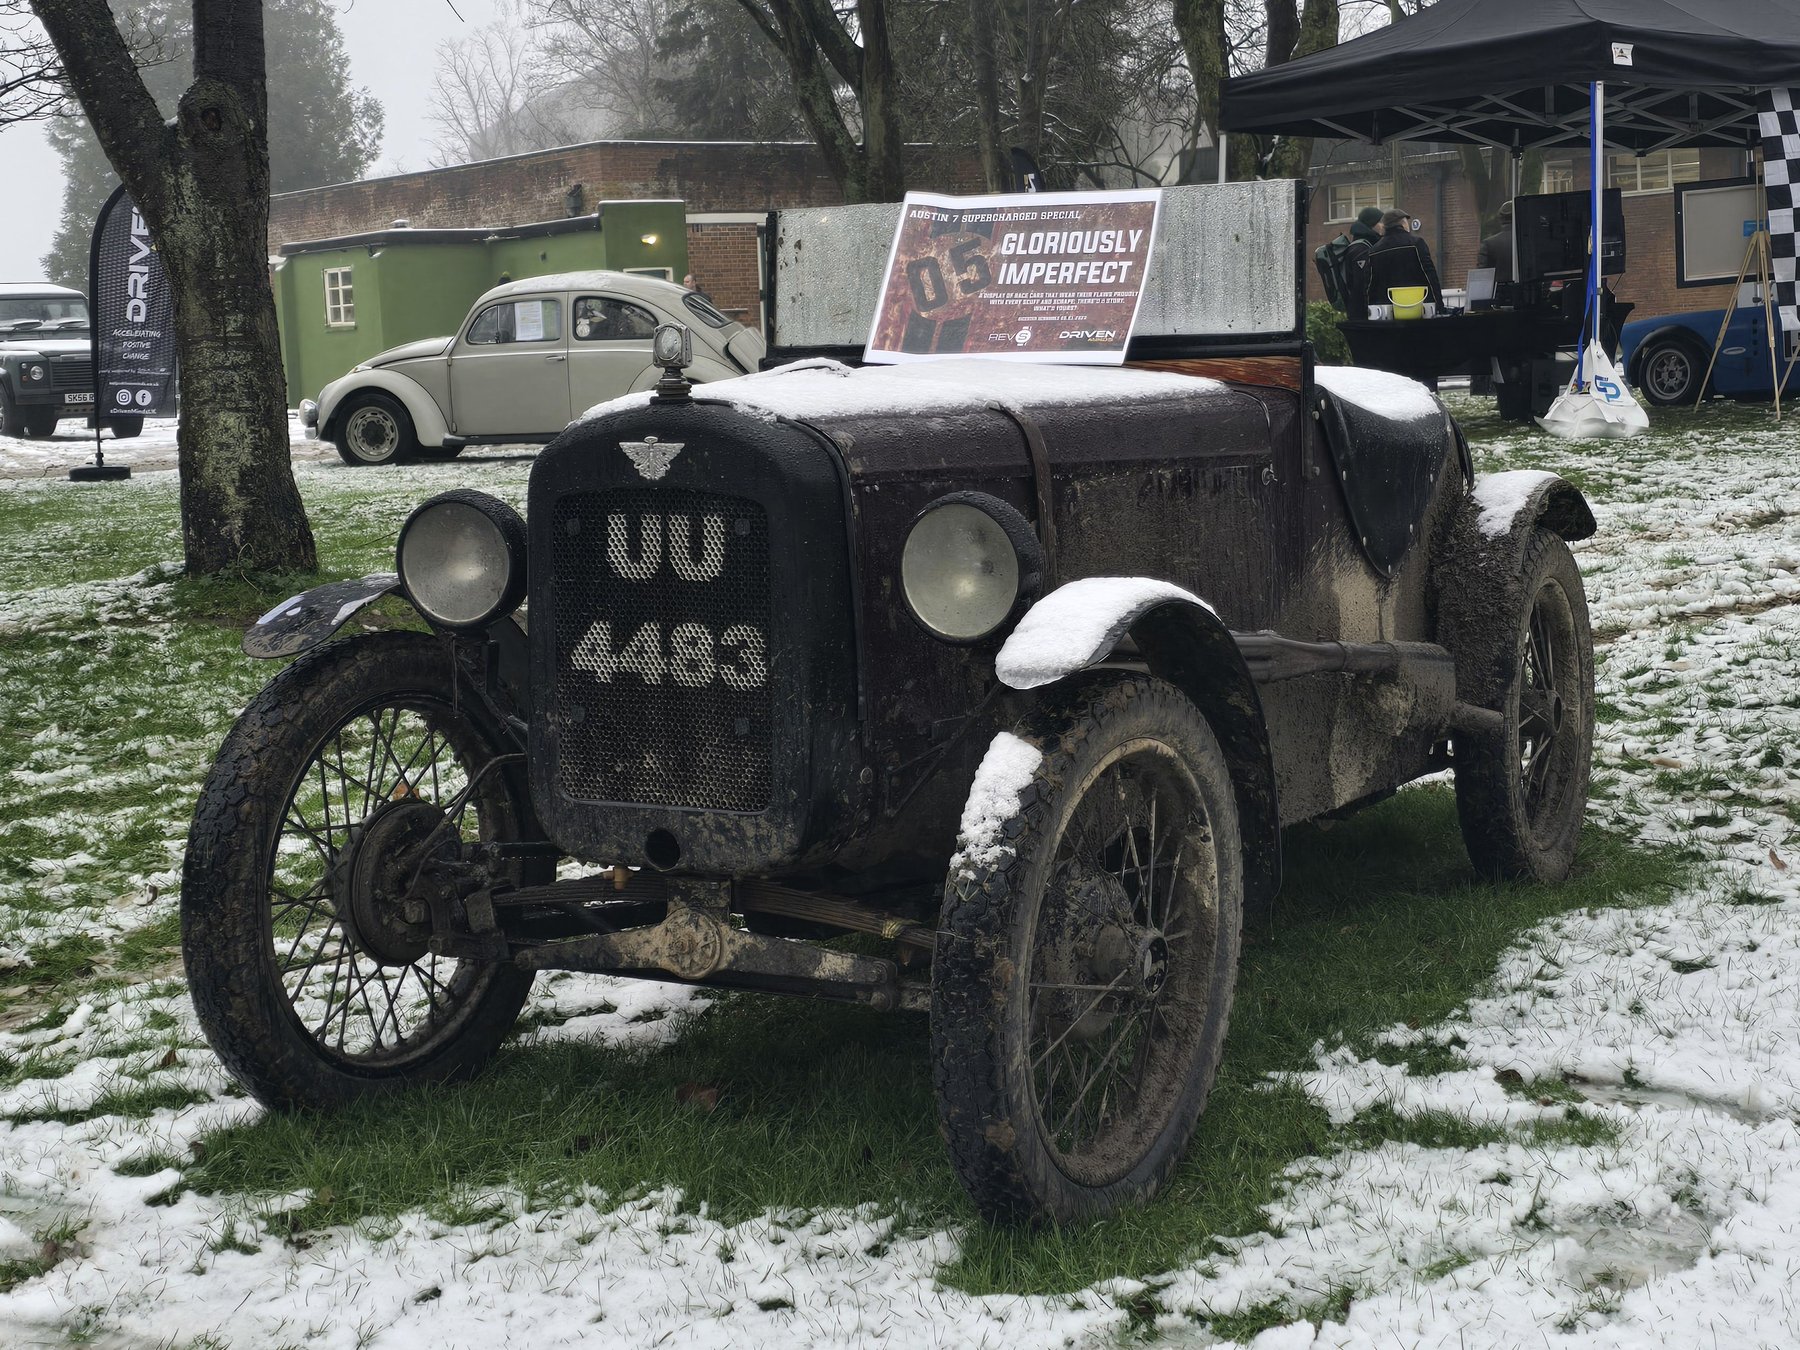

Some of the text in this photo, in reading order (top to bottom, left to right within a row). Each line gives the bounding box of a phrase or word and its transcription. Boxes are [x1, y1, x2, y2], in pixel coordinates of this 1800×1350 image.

[910, 209, 1081, 223] AUSTIN 7 SUPERCHARGED SPECIAL
[1001, 229, 1143, 255] GLORIOUSLY
[126, 205, 150, 323] DRIVE
[997, 261, 1133, 285] IMPERFECT
[122, 341, 152, 349] POSITIVE
[1059, 330, 1116, 339] DRIVEN
[67, 393, 88, 402] SK56
[607, 513, 725, 582] UU
[570, 620, 768, 691] 4483
